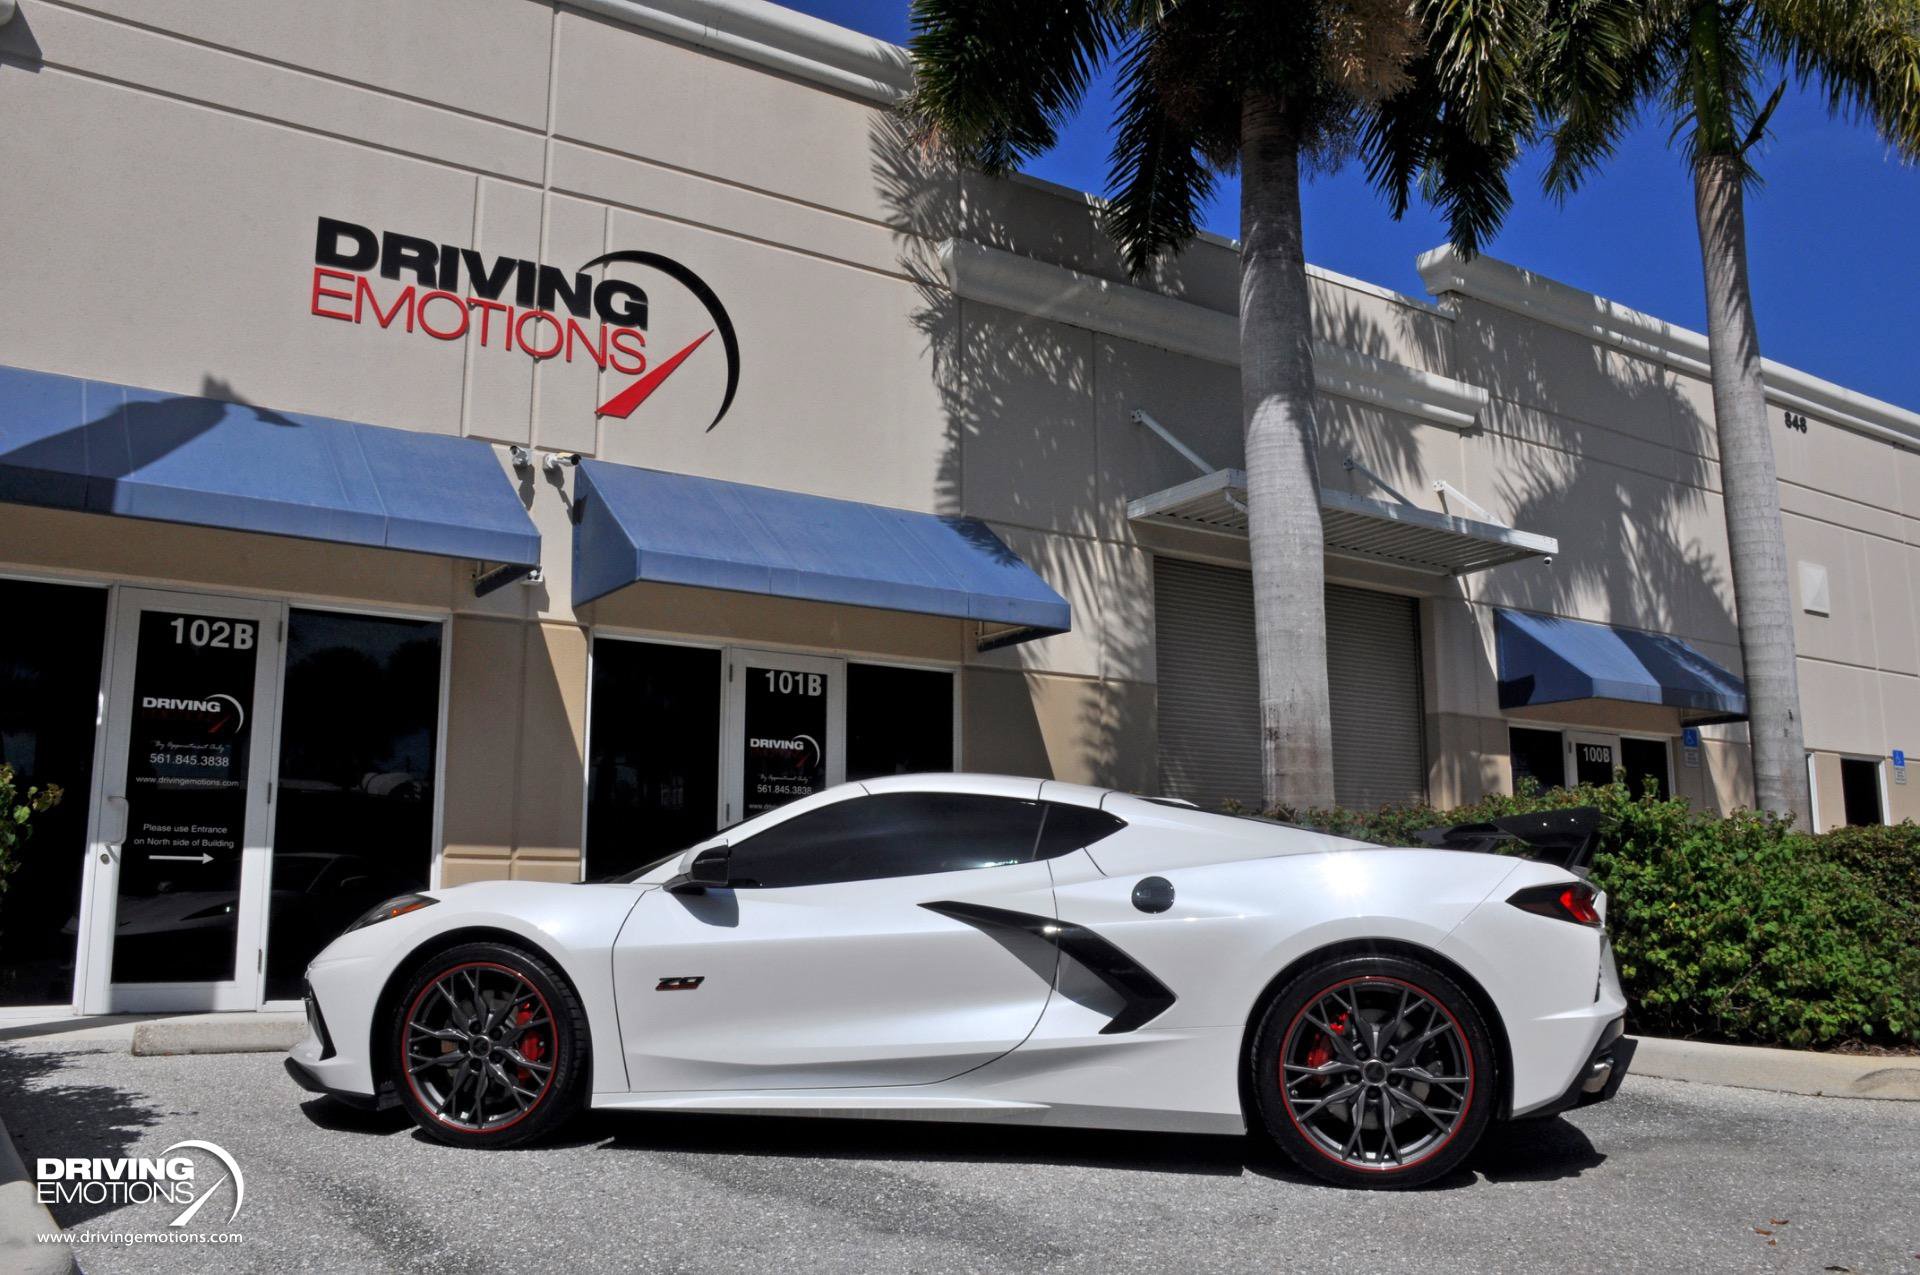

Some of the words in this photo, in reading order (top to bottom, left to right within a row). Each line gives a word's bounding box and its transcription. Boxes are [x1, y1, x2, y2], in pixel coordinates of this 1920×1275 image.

[315, 216, 648, 331] DRIVING
[311, 267, 647, 375] EMOTIONS
[1784, 411, 1807, 434] 848
[170, 617, 254, 650] 102B
[765, 670, 822, 696] 101B
[142, 697, 221, 712] DRIVING
[750, 738, 804, 750] DRIVING
[149, 753, 230, 767] 561.845.3838
[1583, 746, 1610, 763] 100B
[135, 776, 240, 787] www.drivingemotions.com
[143, 823, 172, 832] Please
[191, 825, 228, 834] Entrance
[147, 838, 171, 846] North
[172, 838, 189, 847] side
[191, 839, 201, 847] of
[202, 839, 235, 849] Building
